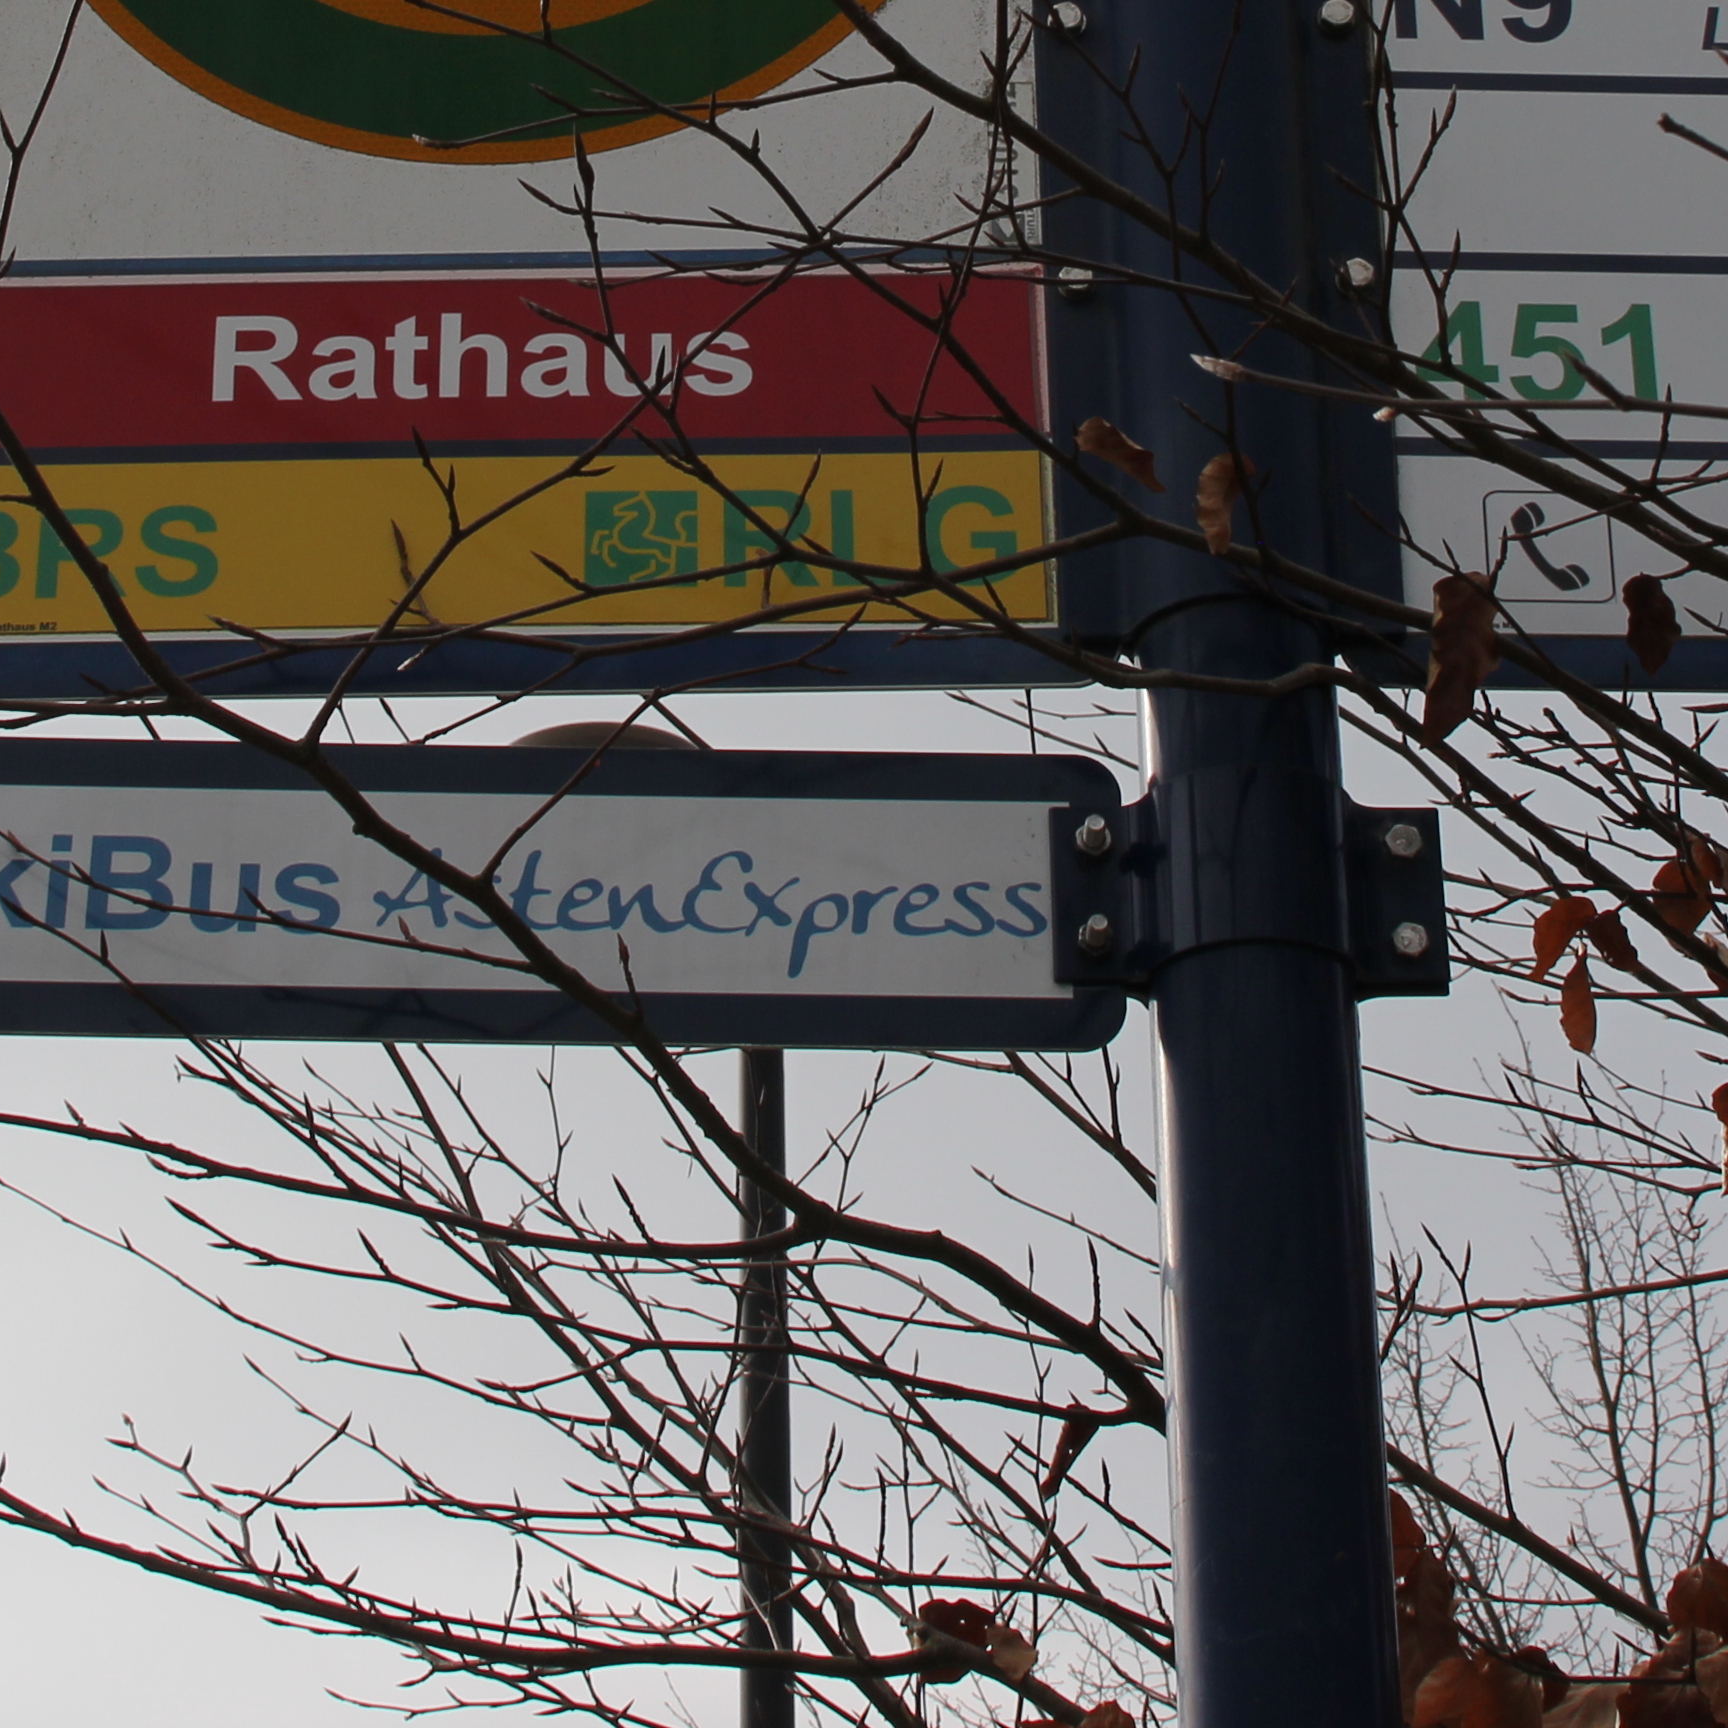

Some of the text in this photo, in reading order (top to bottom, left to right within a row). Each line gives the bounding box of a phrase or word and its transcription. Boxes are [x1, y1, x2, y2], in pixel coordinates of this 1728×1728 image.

[211, 314, 754, 402] Rathaus
[1415, 300, 1658, 406] 451
[724, 485, 1018, 587] RLG
[39, 621, 58, 631] M2
